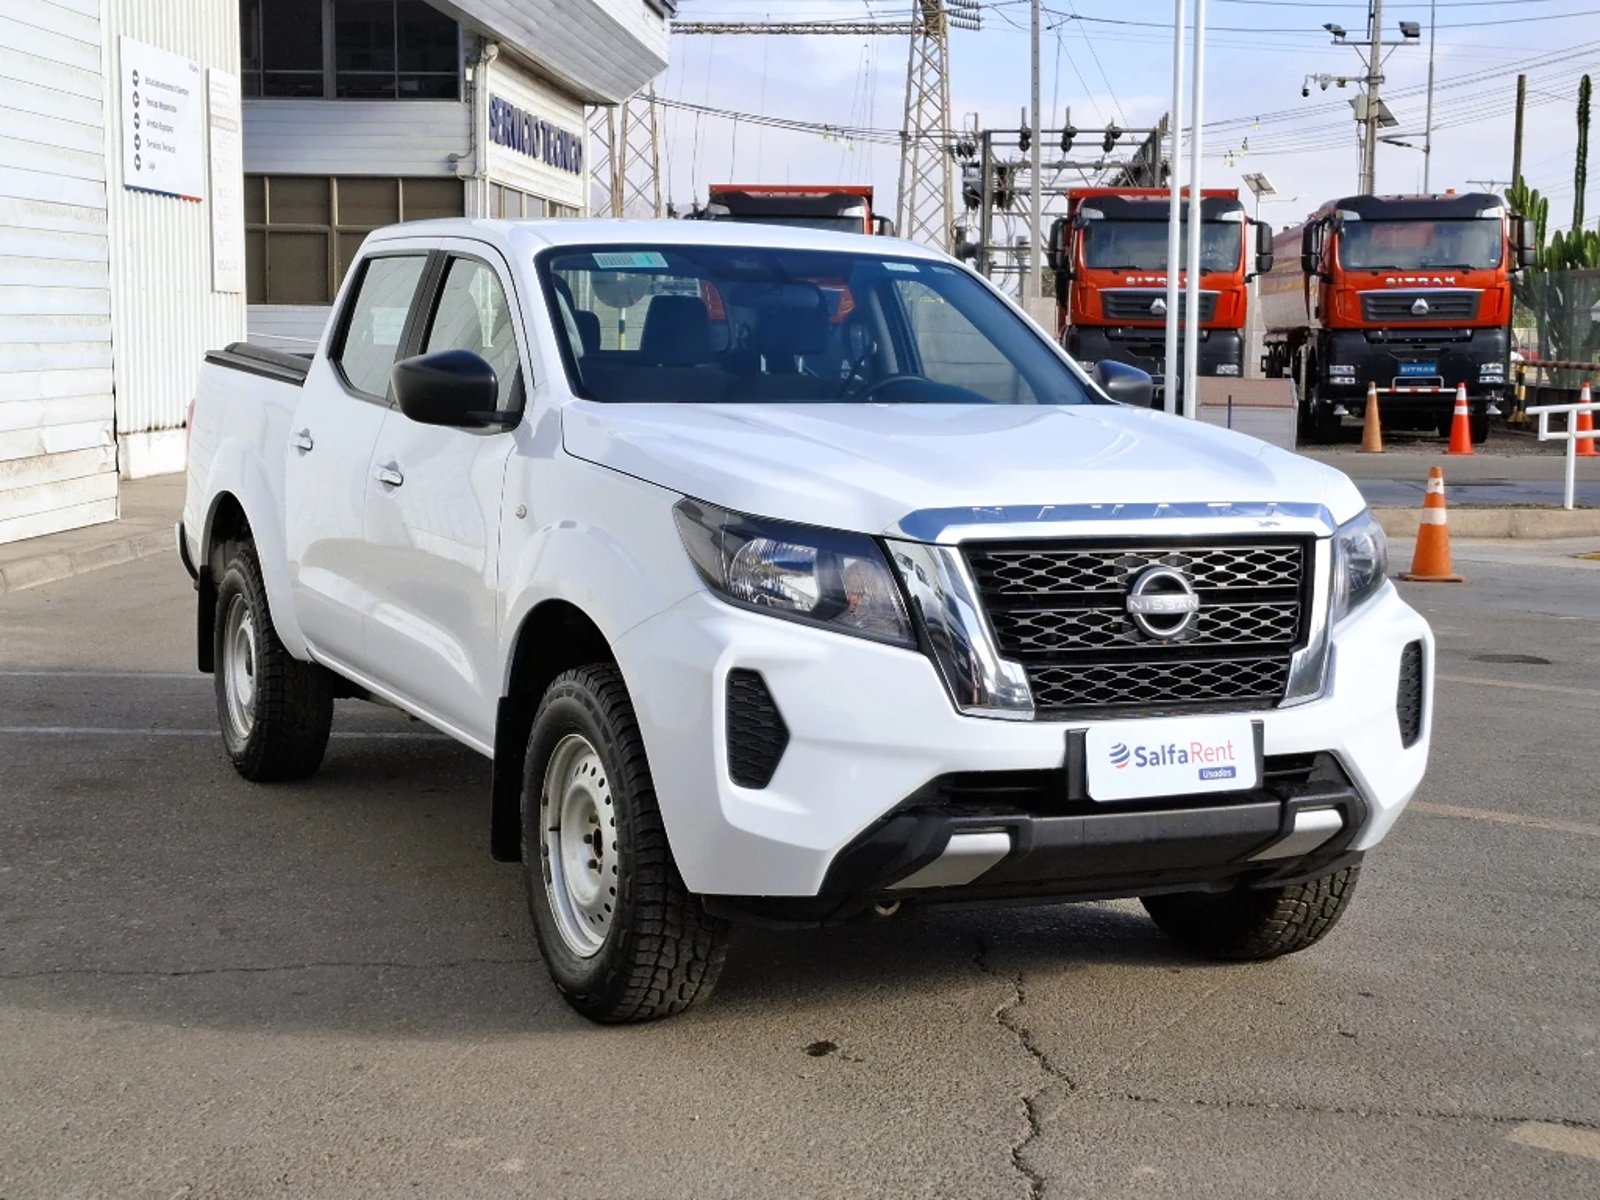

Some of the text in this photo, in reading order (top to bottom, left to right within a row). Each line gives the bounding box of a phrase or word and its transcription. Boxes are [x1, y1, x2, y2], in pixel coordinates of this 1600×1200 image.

[489, 93, 539, 159] SERVICIO
[1385, 276, 1456, 285] SITRAK
[1130, 599, 1198, 610] NISSAN
[1134, 740, 1235, 767] SalfaRent
[1202, 768, 1232, 778] Usados
